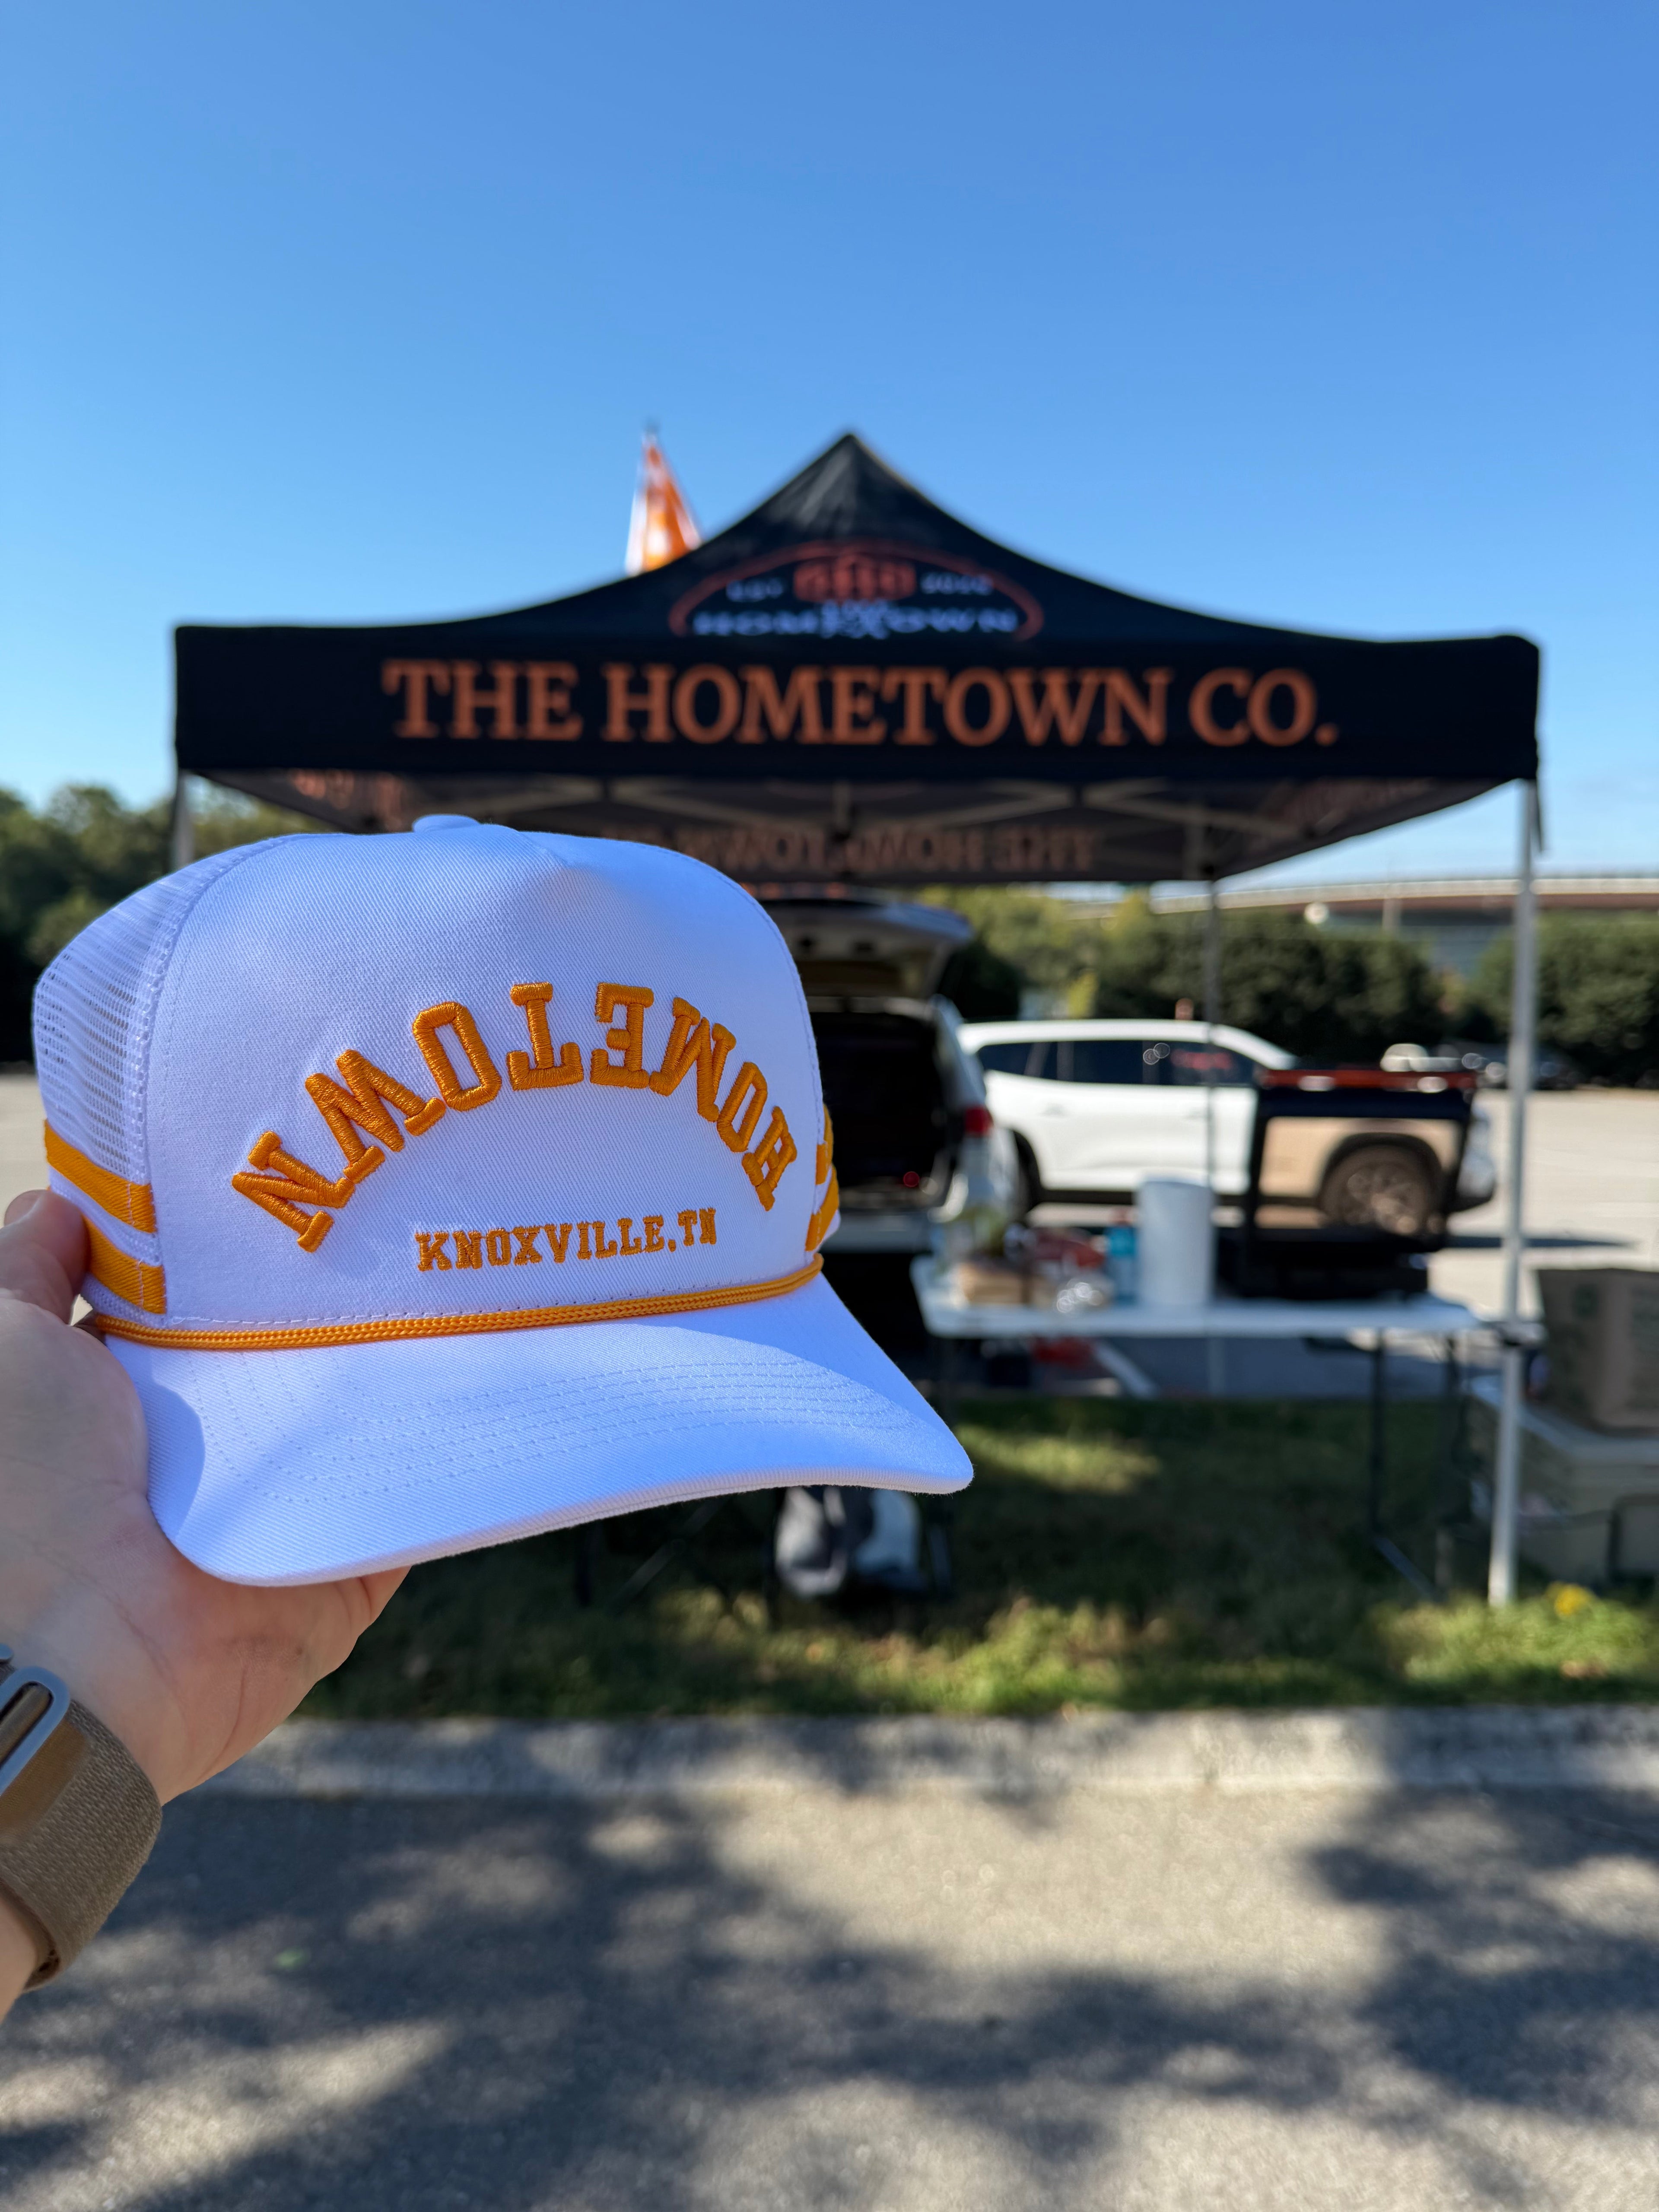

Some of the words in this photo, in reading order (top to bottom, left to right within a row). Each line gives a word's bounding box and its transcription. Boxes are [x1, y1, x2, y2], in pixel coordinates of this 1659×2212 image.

[383, 661, 582, 741] THE
[604, 664, 1172, 747] HOMETOWN
[1189, 669, 1336, 747] CO.
[232, 982, 797, 1253] HOMETOWN
